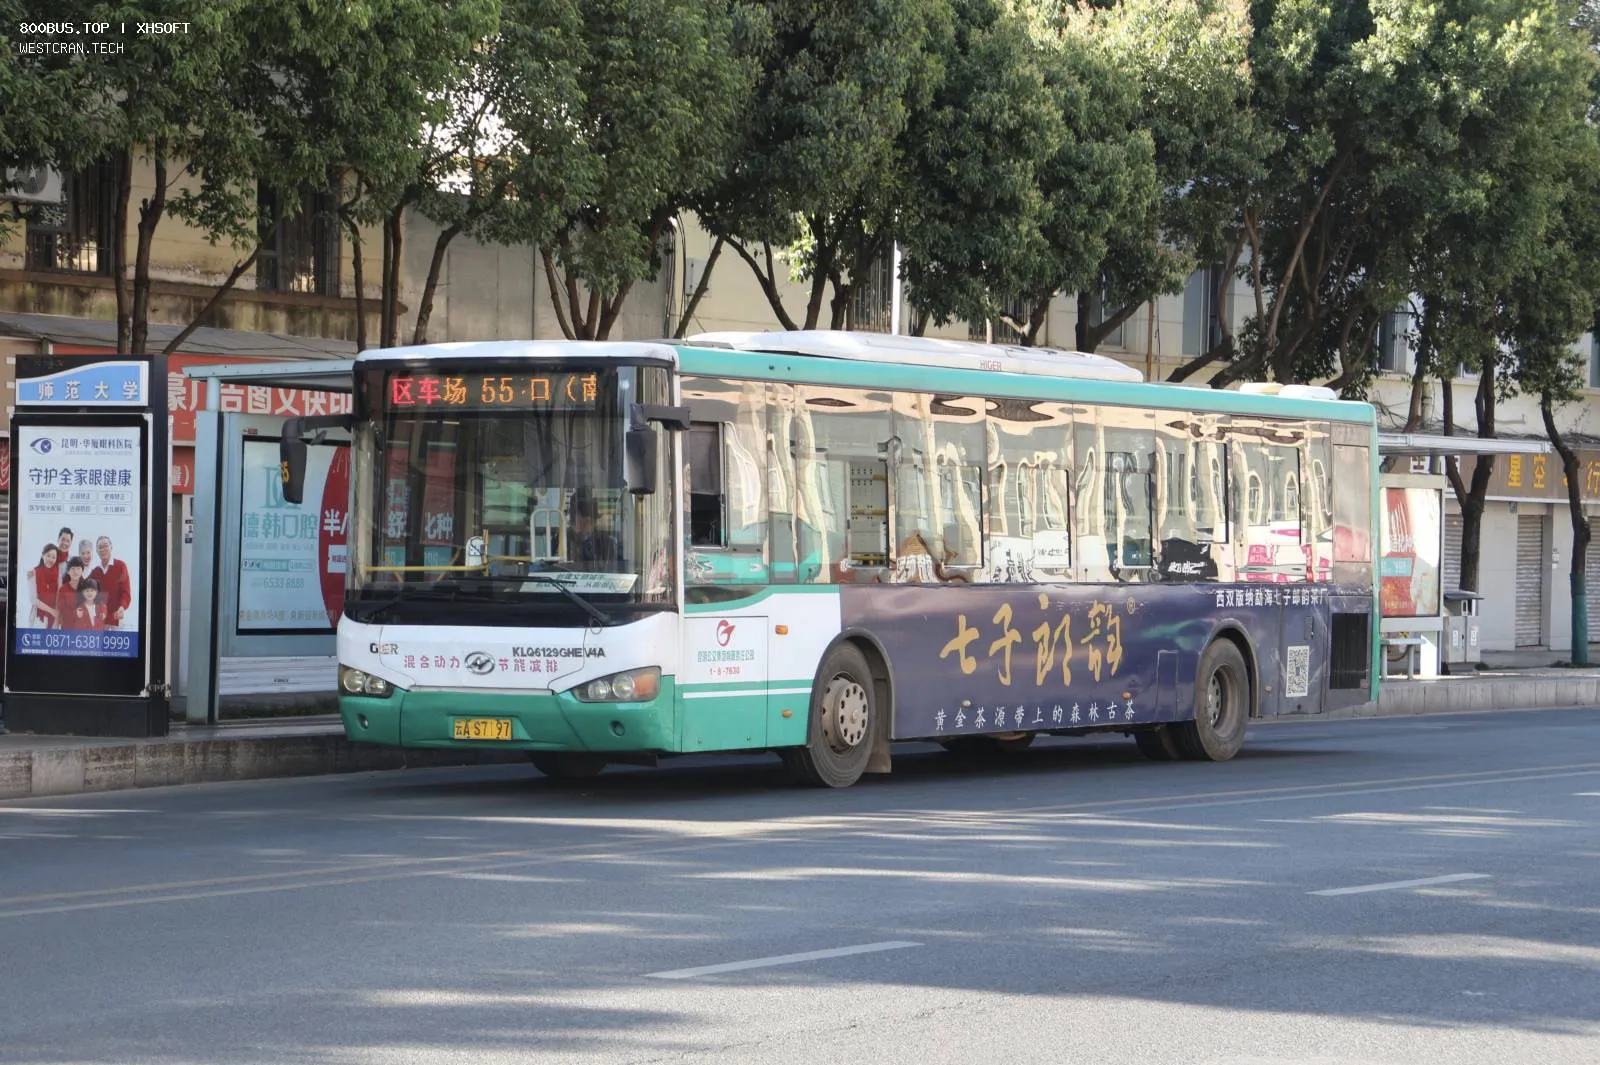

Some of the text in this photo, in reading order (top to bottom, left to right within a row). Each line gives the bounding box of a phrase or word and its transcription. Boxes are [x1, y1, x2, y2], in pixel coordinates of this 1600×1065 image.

[979, 360, 1002, 371] HIGER
[38, 380, 140, 400] 师范大学
[391, 376, 467, 405] 区车场
[481, 377, 514, 403] 55
[28, 467, 132, 487] 守护全家眼健康
[243, 512, 318, 540] 德韩口腔
[323, 508, 350, 537] 半
[45, 634, 100, 649] 0871-6381
[103, 635, 130, 650] 9999
[404, 655, 558, 673] 混合动力 节能减排
[935, 700, 1136, 731] 黄金茶源带上的森林古茶
